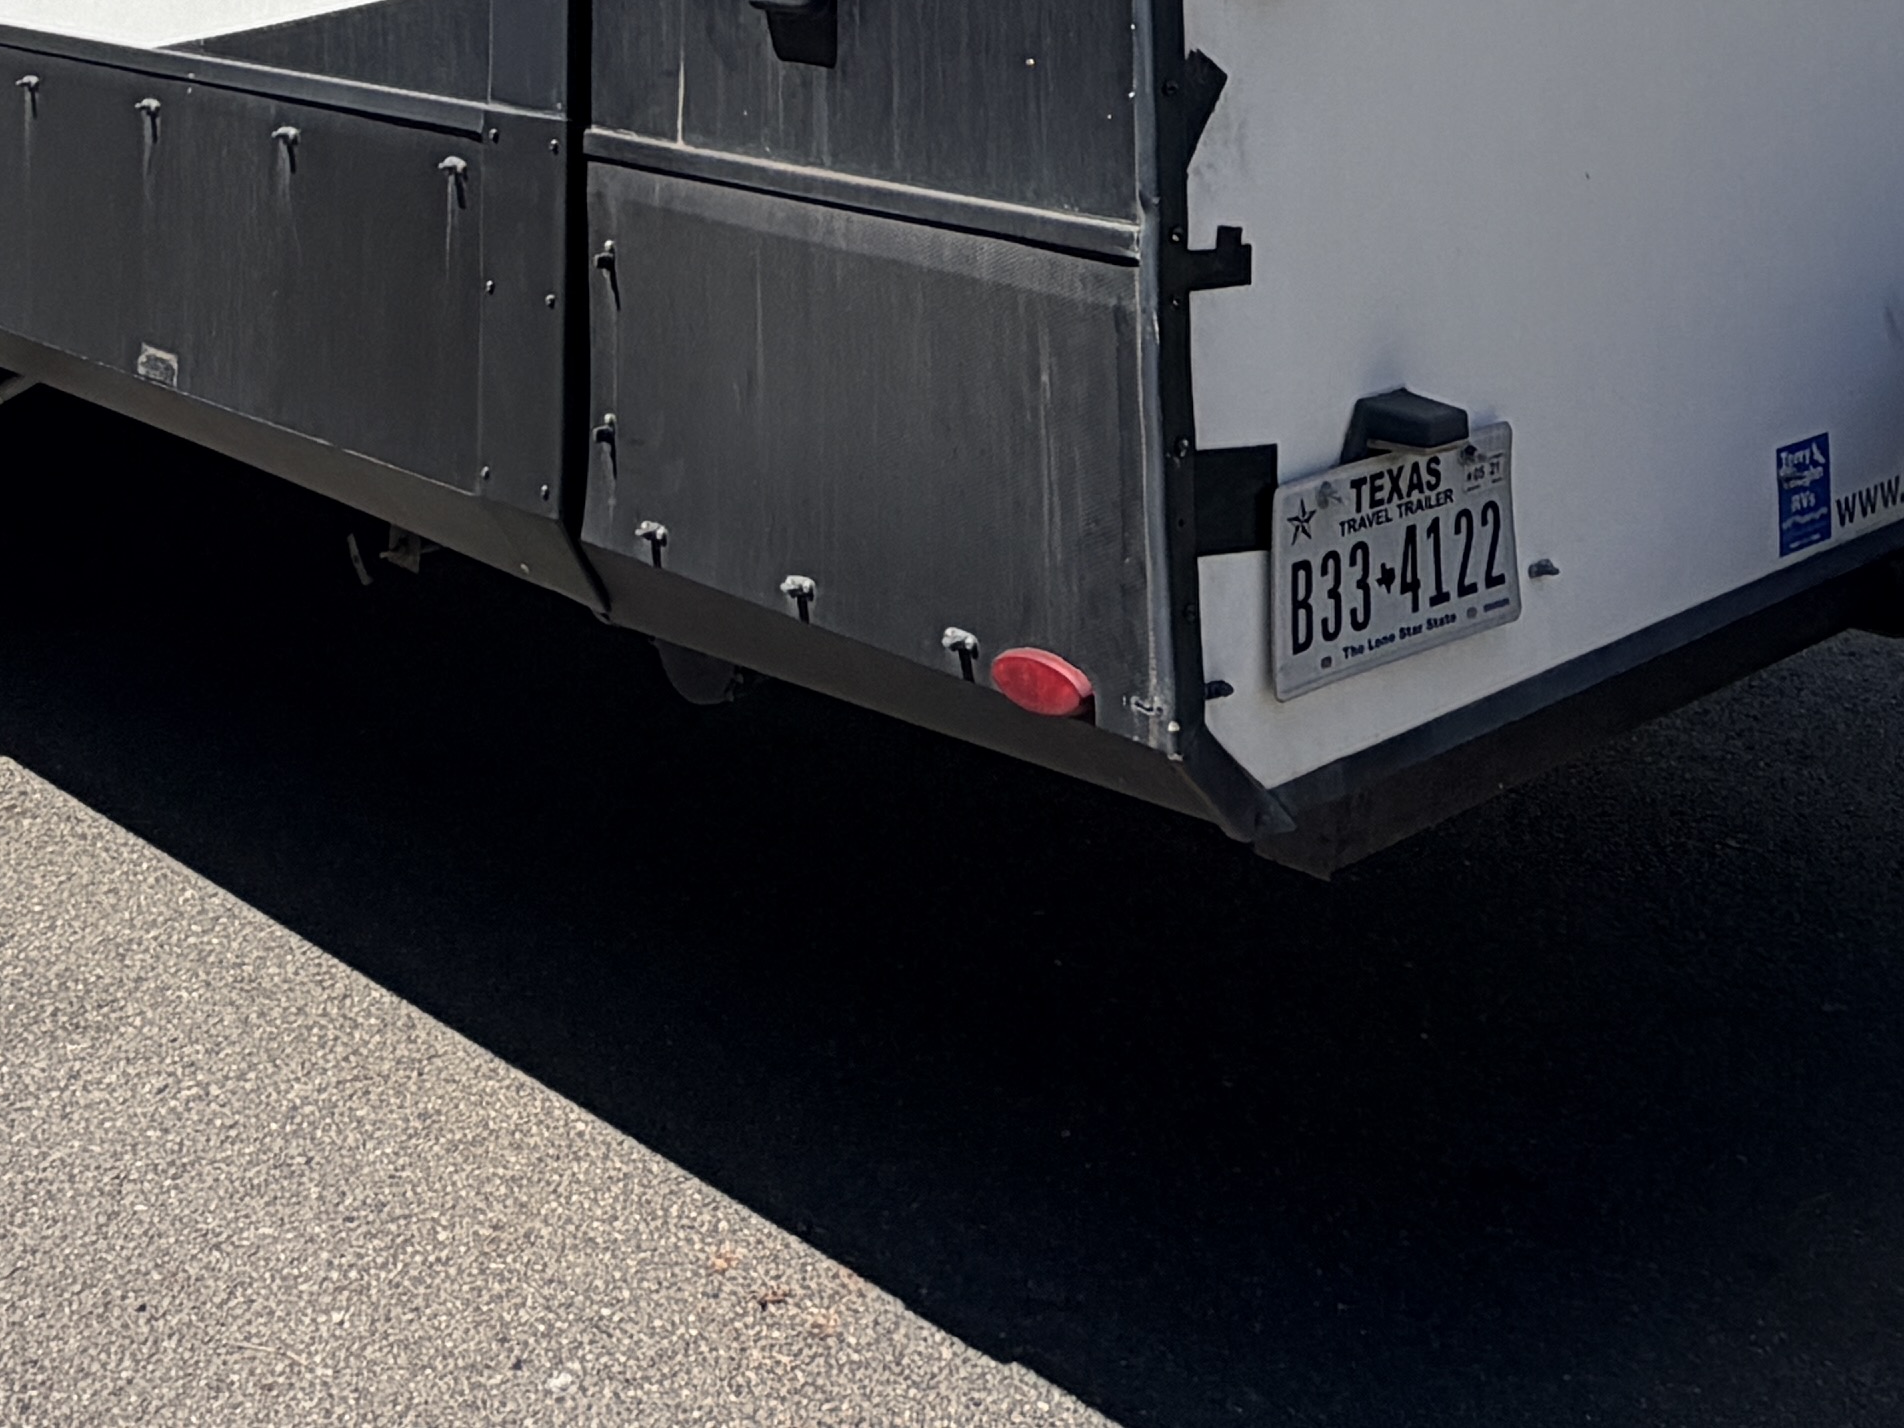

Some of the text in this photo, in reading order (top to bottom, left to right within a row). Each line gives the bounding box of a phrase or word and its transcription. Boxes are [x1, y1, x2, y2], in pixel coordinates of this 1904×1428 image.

[1350, 456, 1442, 514] TEXAS
[1339, 488, 1454, 537] TRAVEL TRAILER
[1342, 613, 1457, 660] The Lone Star State
